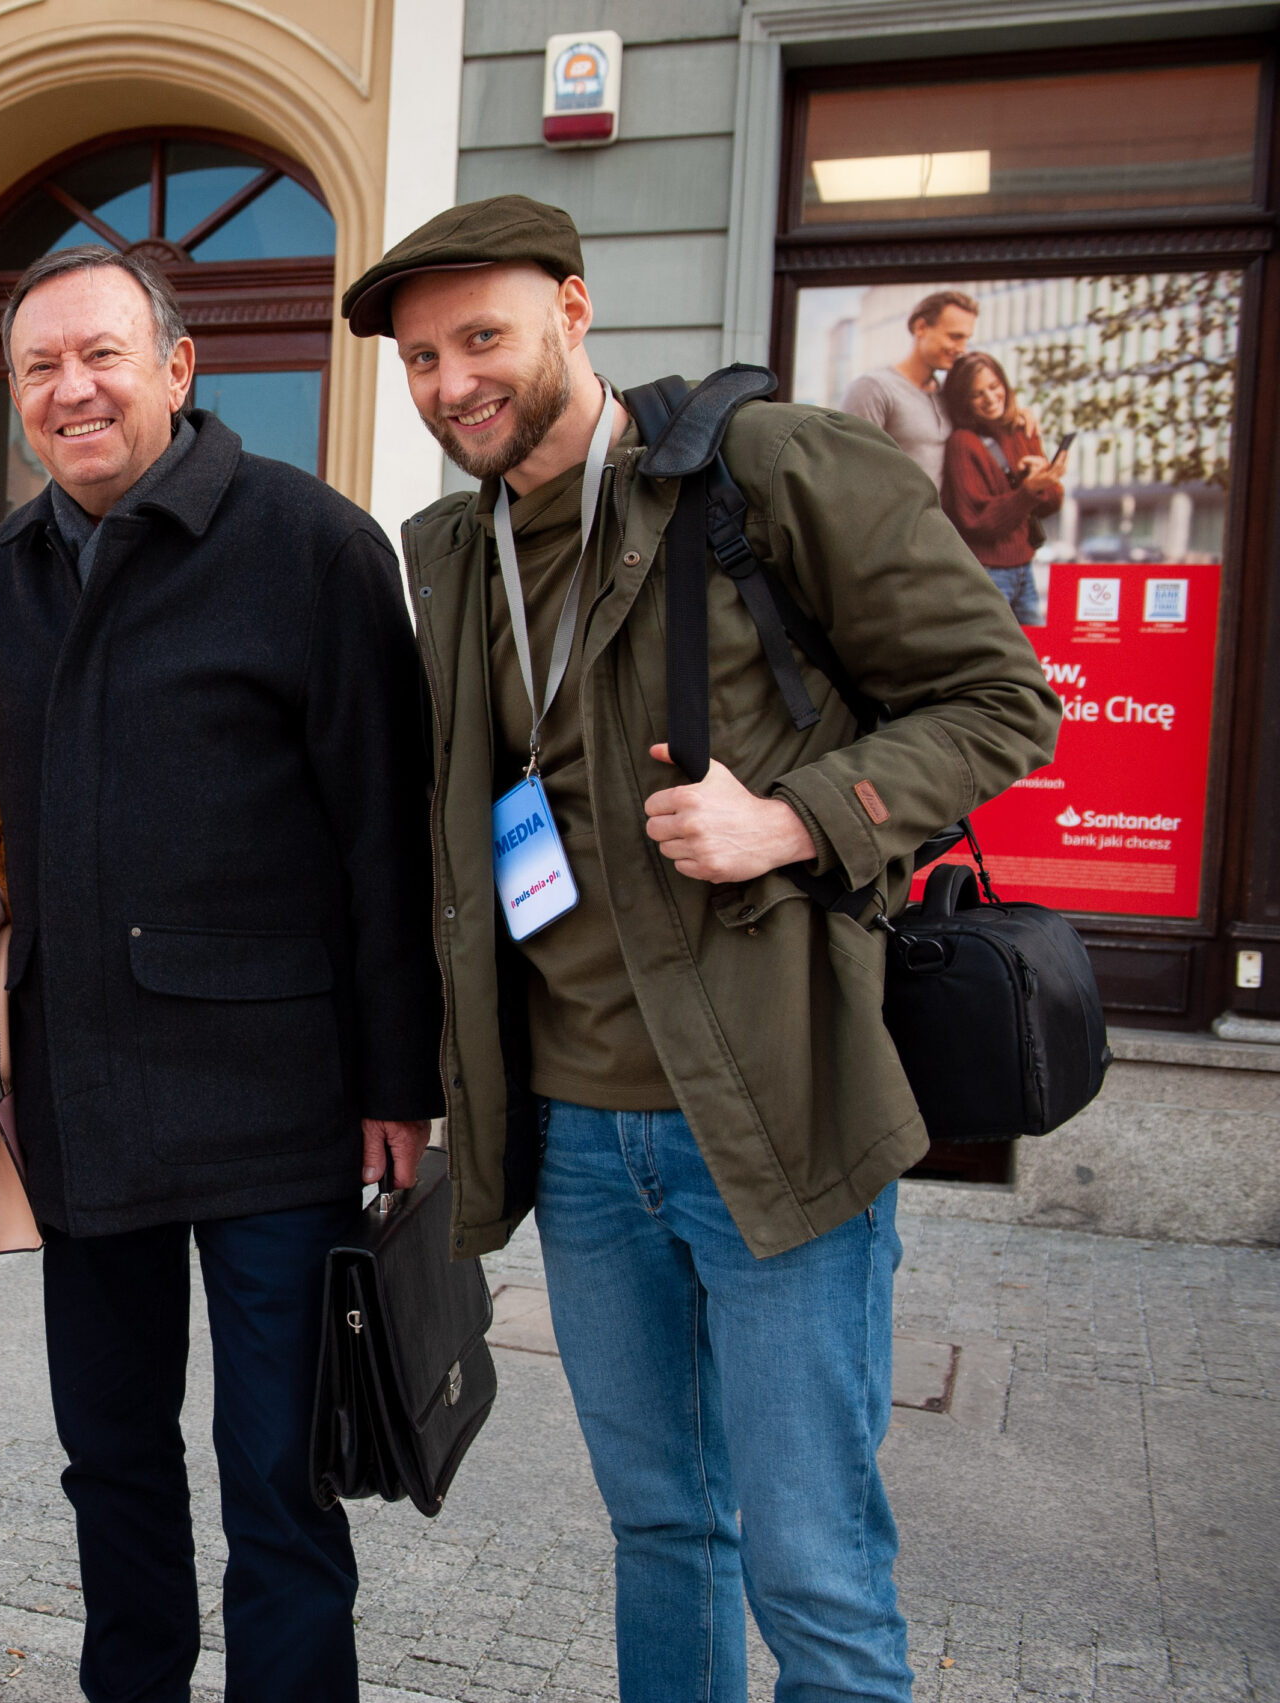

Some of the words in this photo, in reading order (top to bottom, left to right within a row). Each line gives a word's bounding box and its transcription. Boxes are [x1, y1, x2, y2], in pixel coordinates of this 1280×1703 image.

[1040, 656, 1086, 688] ów,
[1061, 694, 1099, 722] kie
[1105, 695, 1175, 731] Chcę
[494, 812, 545, 859] MEDIA
[1082, 810, 1181, 831] Santander
[1062, 832, 1096, 846] bank
[1097, 833, 1123, 850] jaki
[1125, 835, 1172, 850] chcesz
